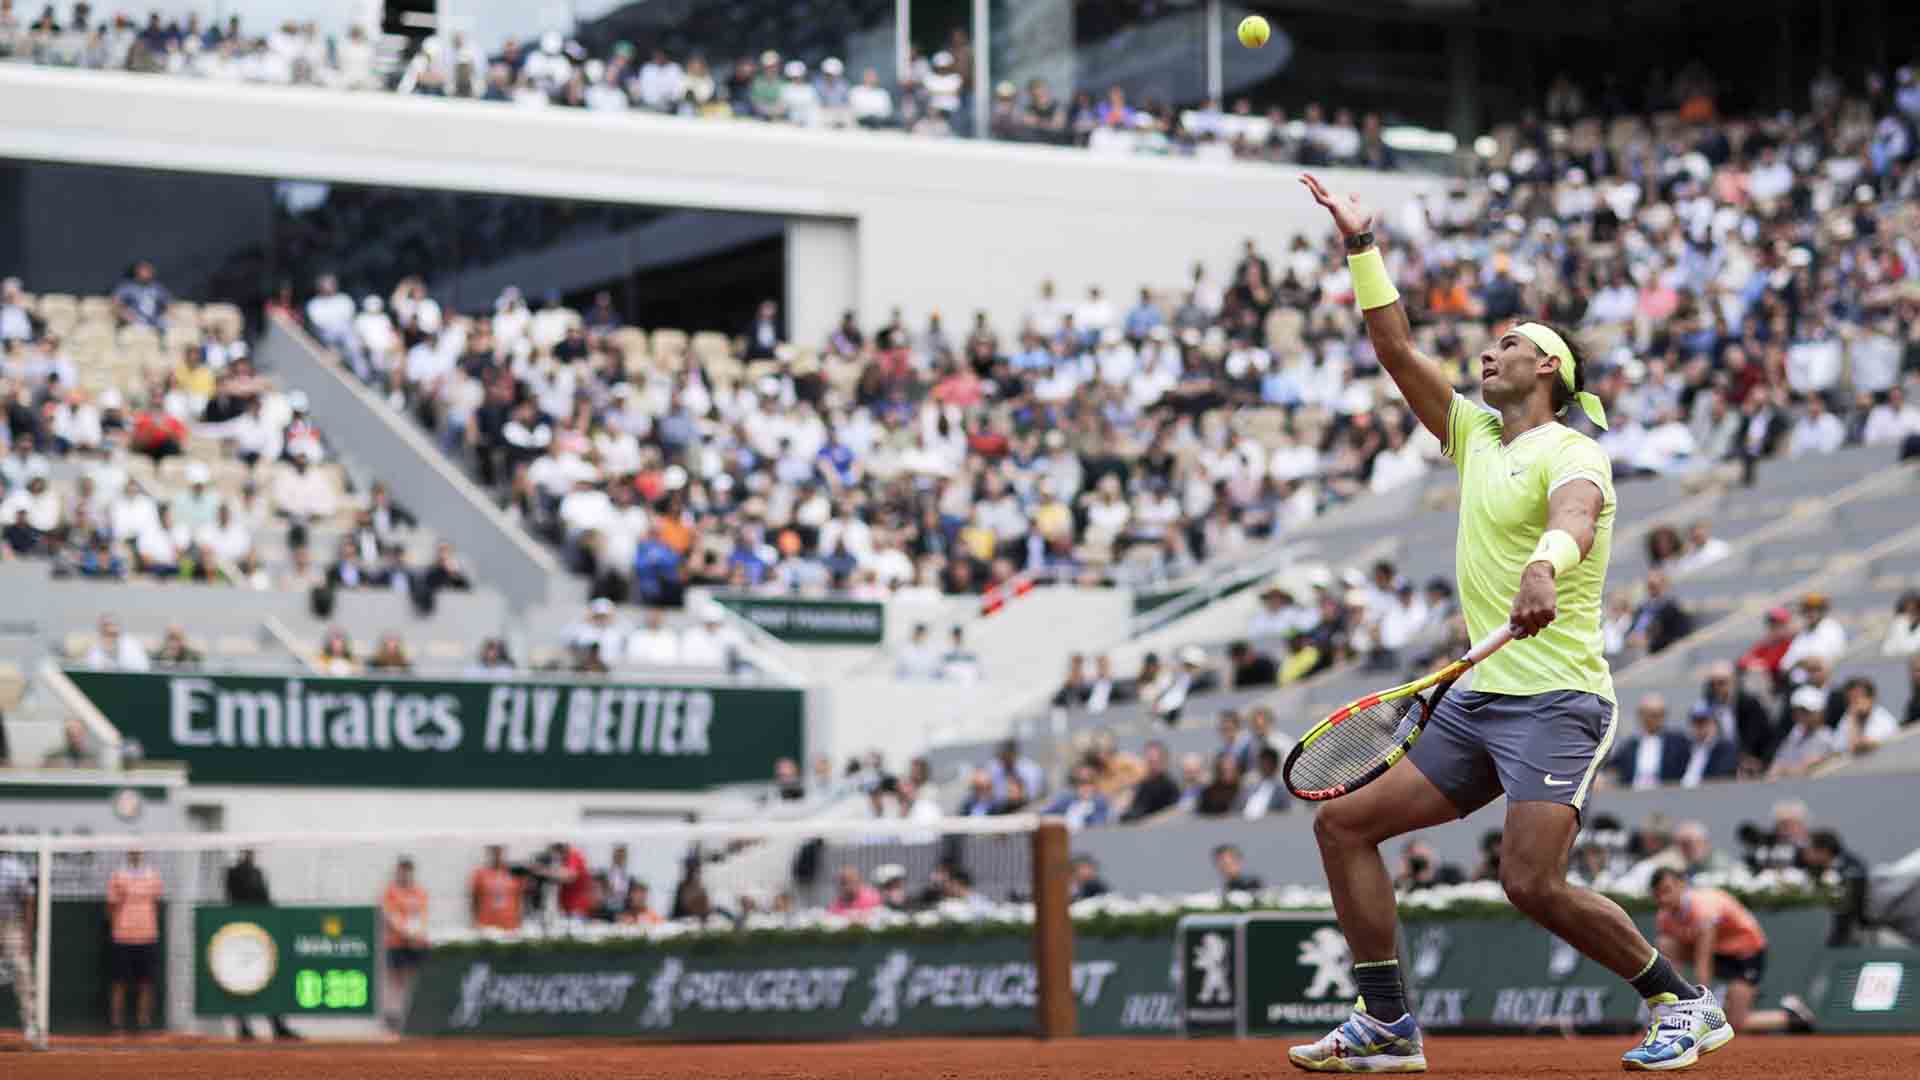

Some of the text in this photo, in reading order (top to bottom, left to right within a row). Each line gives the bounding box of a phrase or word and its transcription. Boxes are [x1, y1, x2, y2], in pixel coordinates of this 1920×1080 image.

[169, 678, 714, 756] Emirates FLY BETTER
[484, 972, 637, 1012] PEUGEOT
[678, 966, 855, 1011] PEUGEOT
[1491, 986, 1609, 1025] ROLEX
